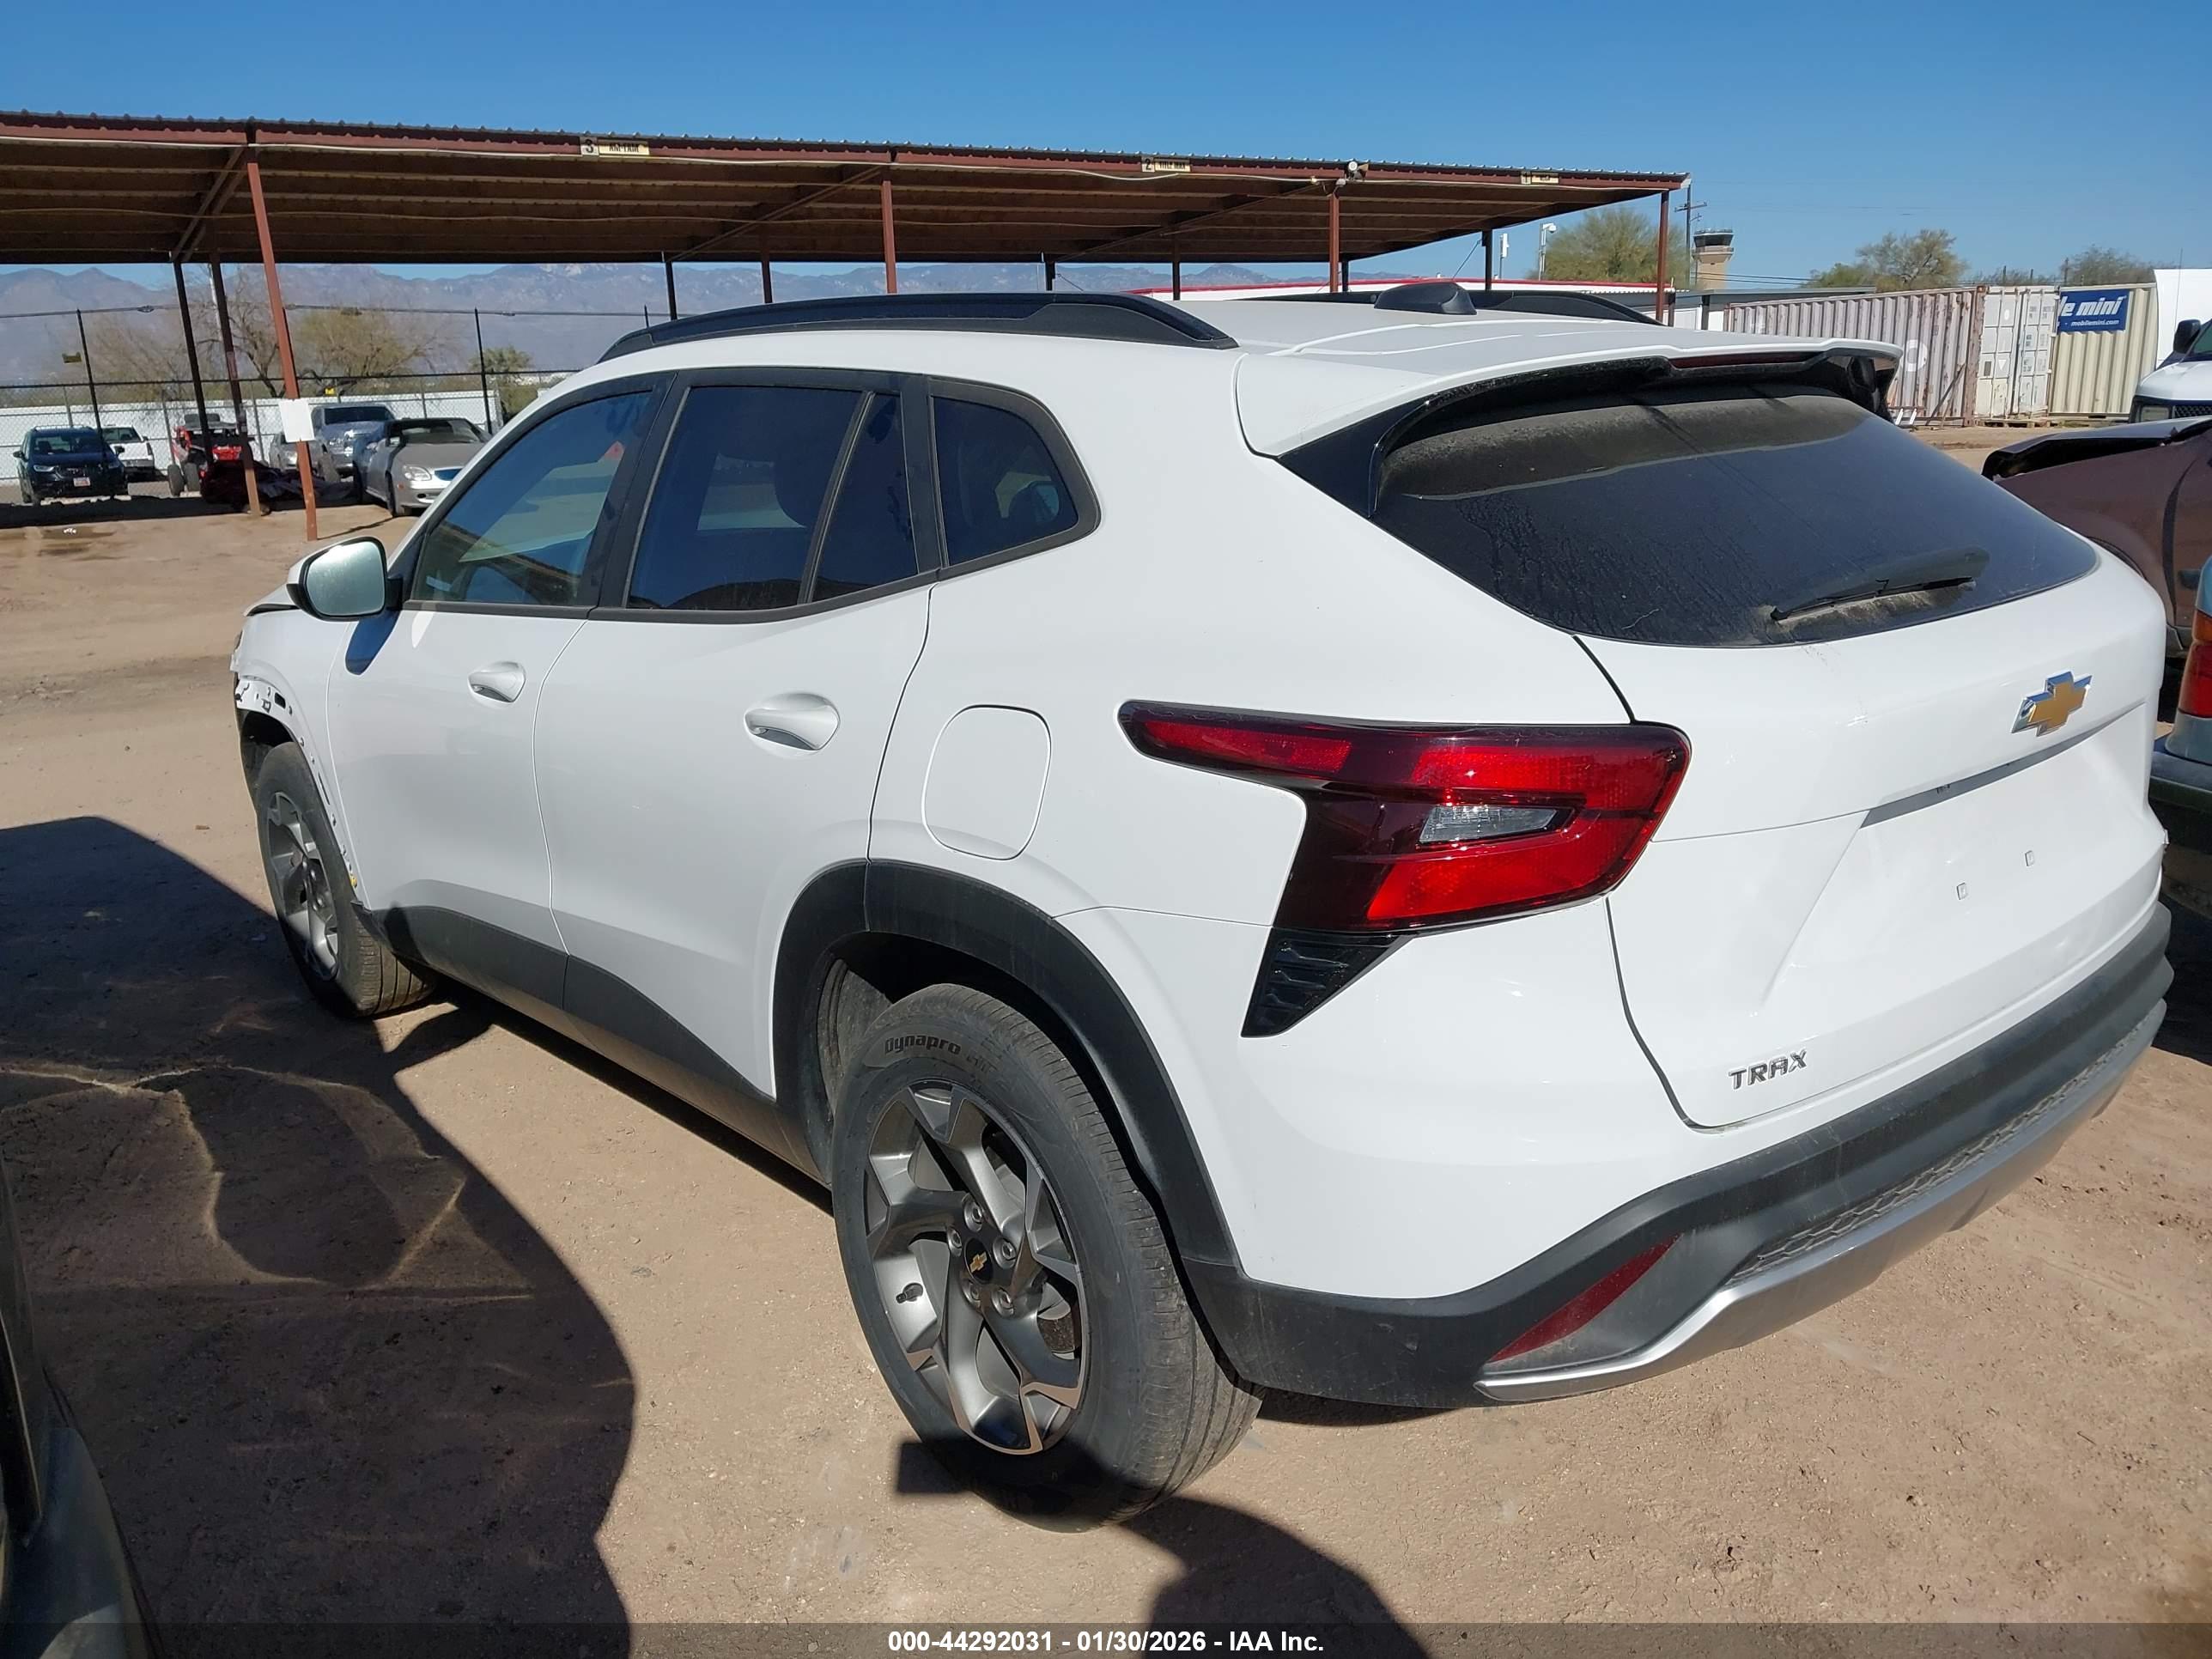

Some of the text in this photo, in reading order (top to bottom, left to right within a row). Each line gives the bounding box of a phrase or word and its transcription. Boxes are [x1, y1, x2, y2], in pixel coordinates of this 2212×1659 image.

[585, 139, 593, 154] 3
[1145, 158, 1152, 170] 2
[2075, 295, 2123, 316] mini
[2071, 319, 2119, 327] mobilemini.com
[885, 1035, 962, 1054] Dynapro
[1729, 1048, 1808, 1090] TRAX
